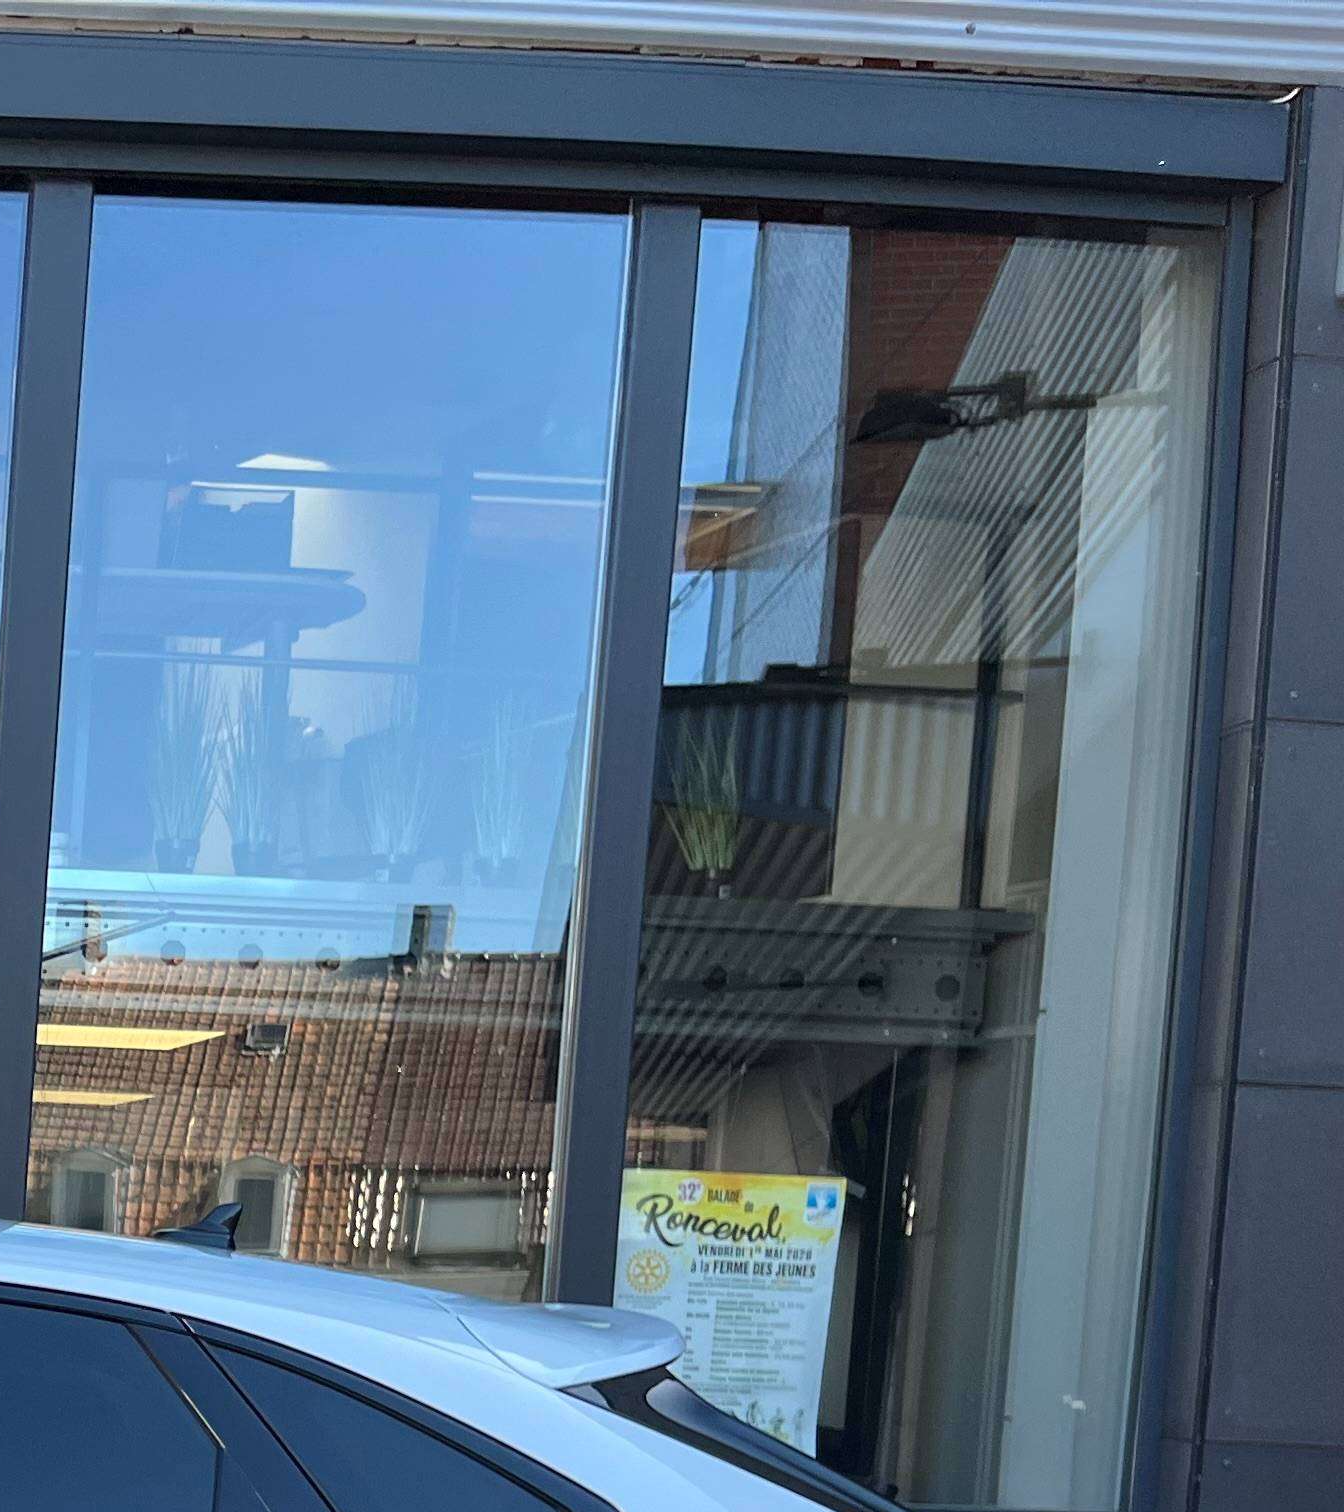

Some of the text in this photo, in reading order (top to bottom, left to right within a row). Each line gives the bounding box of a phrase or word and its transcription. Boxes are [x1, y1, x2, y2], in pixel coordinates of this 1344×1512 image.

[698, 1244, 745, 1258] VENDREDI
[765, 1247, 782, 1260] MAI
[713, 1260, 749, 1275] FERME
[752, 1262, 772, 1276] DES
[775, 1262, 816, 1278] JEUNES
